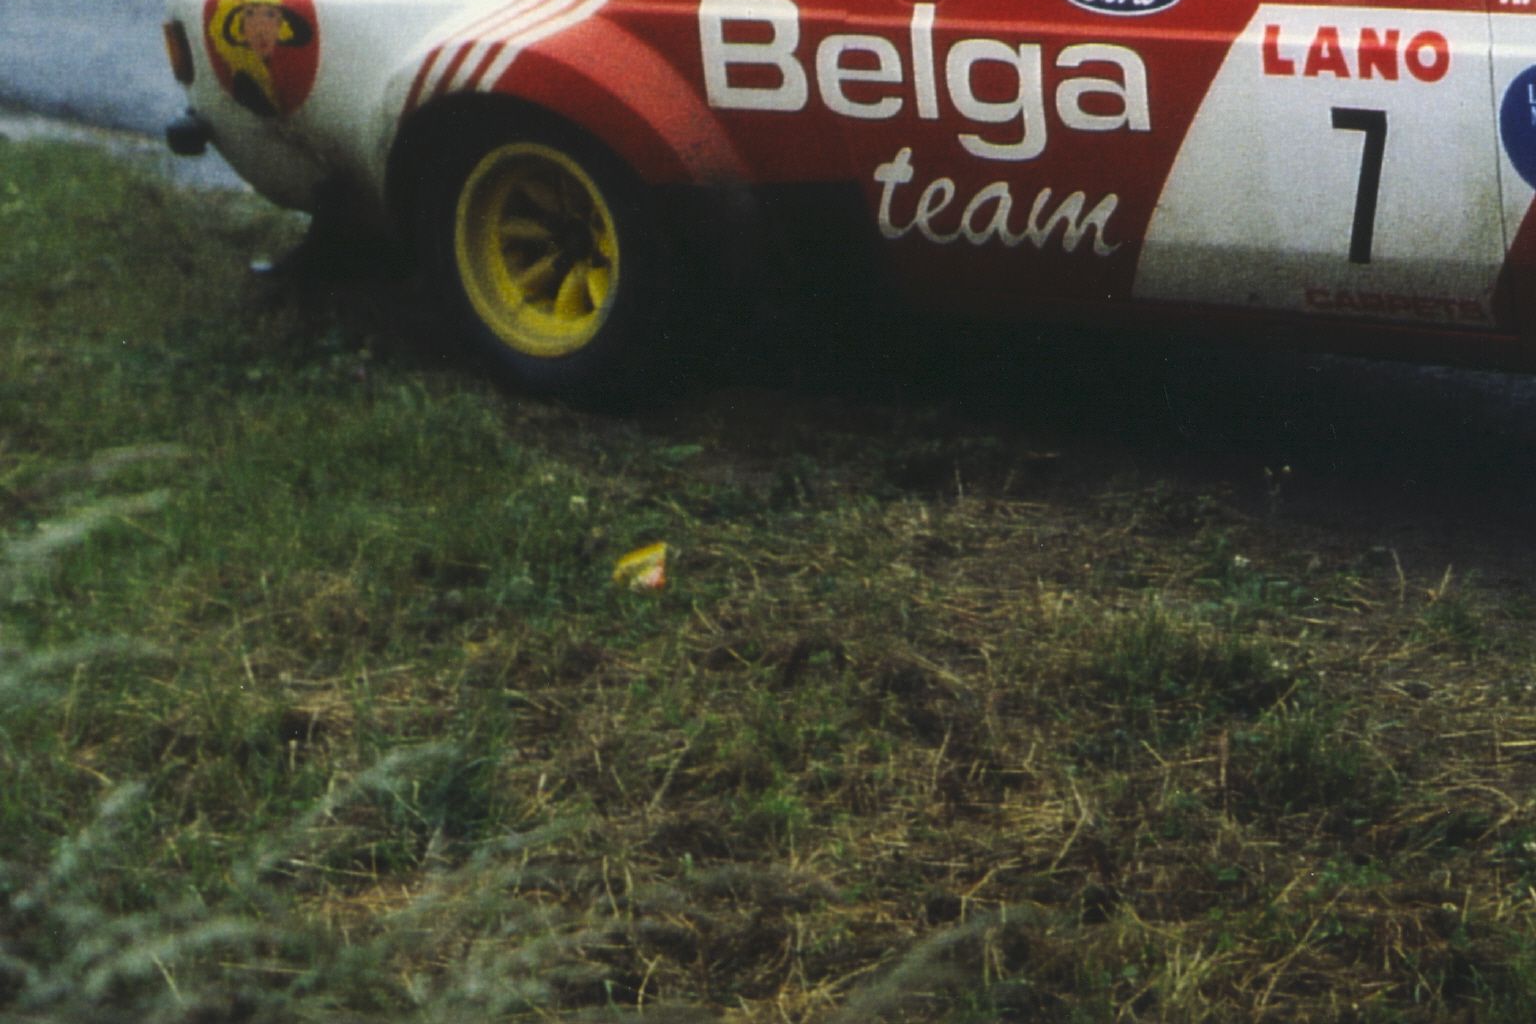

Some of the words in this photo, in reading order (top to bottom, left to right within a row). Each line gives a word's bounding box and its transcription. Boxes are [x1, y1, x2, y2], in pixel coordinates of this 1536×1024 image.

[1261, 24, 1451, 84] LANO
[873, 146, 1122, 257] team
[1331, 106, 1388, 264] 7
